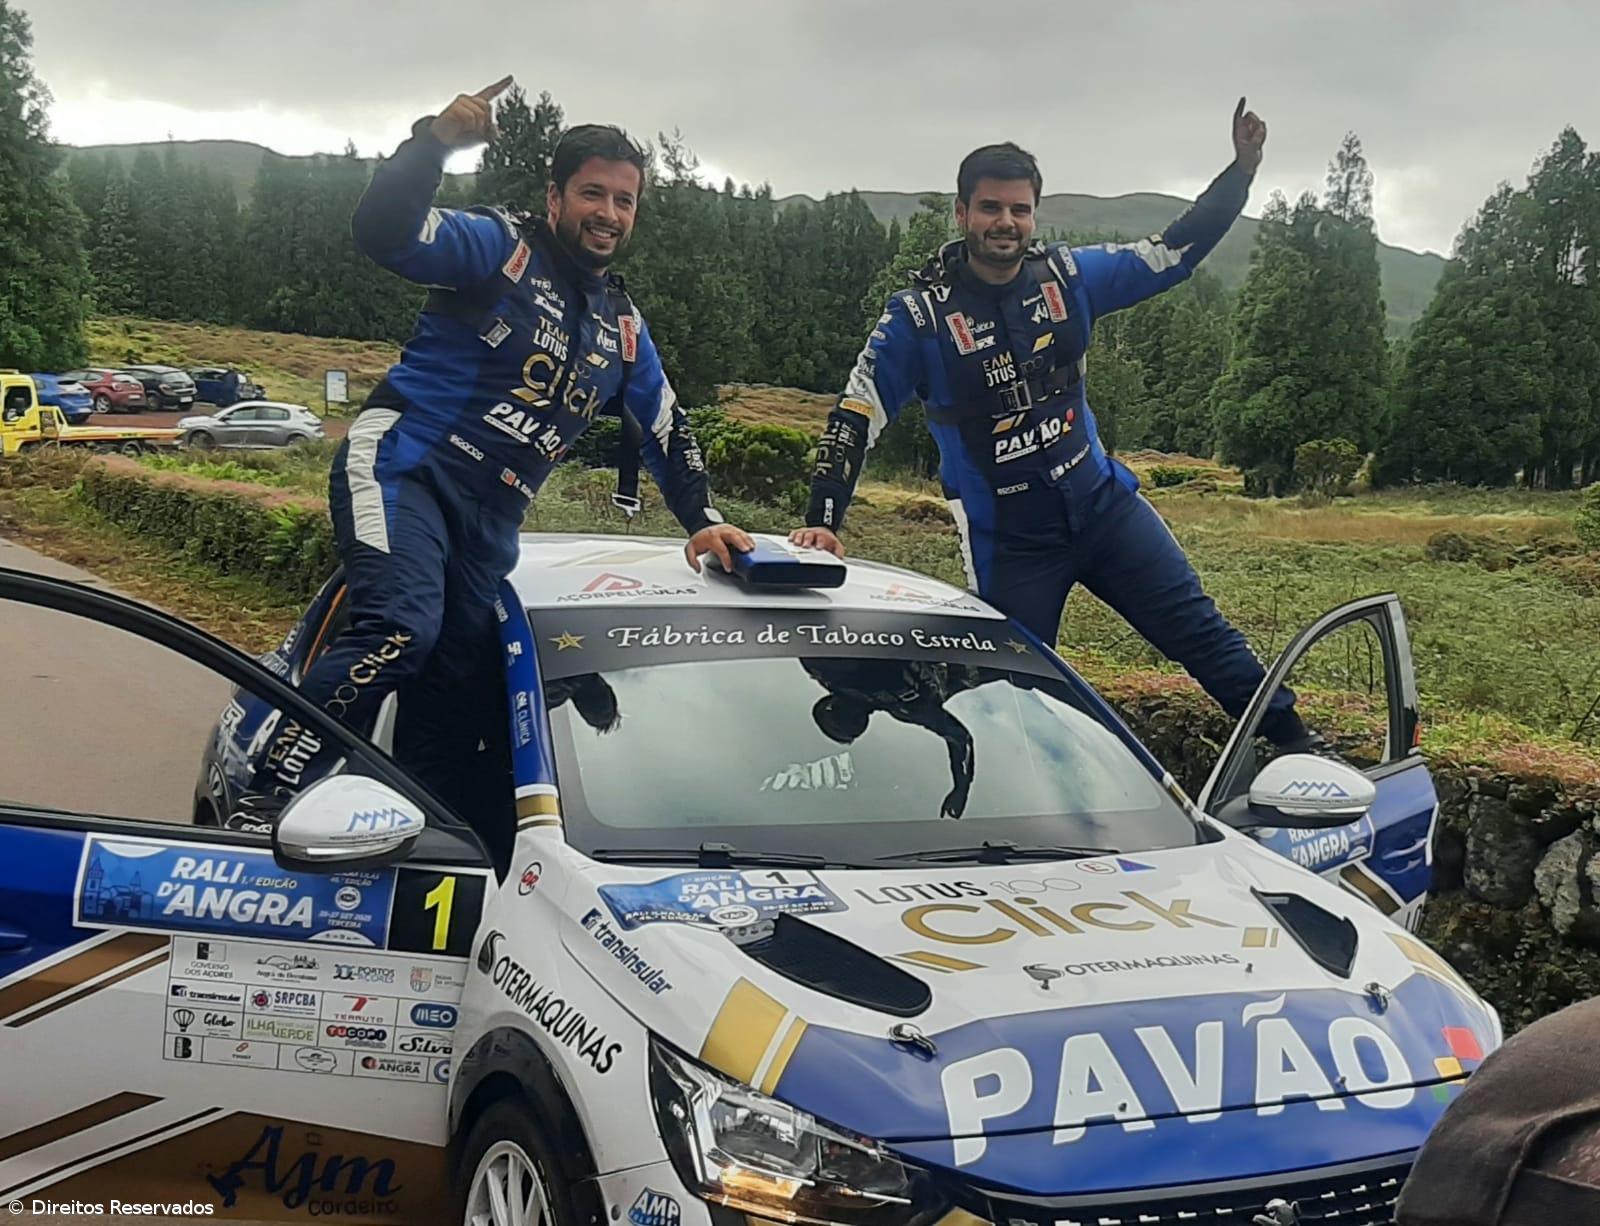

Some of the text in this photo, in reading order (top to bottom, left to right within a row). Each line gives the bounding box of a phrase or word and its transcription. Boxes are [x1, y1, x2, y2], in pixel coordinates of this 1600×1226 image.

[533, 329, 568, 361] LOTUS
[982, 351, 1013, 371] EAM
[523, 352, 601, 422] Click
[986, 364, 1016, 387] OTUS
[995, 418, 1061, 456] PAVÃO
[608, 624, 997, 653] Fábrica de Tabaco Estrela
[350, 631, 412, 684] Click
[277, 728, 322, 785] LOTU
[171, 857, 244, 884] RALI
[255, 876, 298, 889] EDIÇÃO
[766, 872, 789, 885] 1
[678, 885, 826, 910] D'ANGRA
[682, 879, 742, 895] RALI
[855, 880, 988, 905] LOTUS
[157, 881, 314, 928] D'ANGRA
[424, 876, 457, 952] 1
[900, 890, 1240, 946] Click
[594, 922, 672, 995] transinsular
[274, 991, 316, 1007] SRPCBA
[203, 1012, 235, 1027] Globo
[416, 1008, 453, 1023] MEO
[327, 1026, 387, 1041] TUCOPI
[378, 1063, 421, 1075] ANGRA
[940, 992, 1416, 1167] PAVÃO
[634, 1191, 680, 1220] AMP
